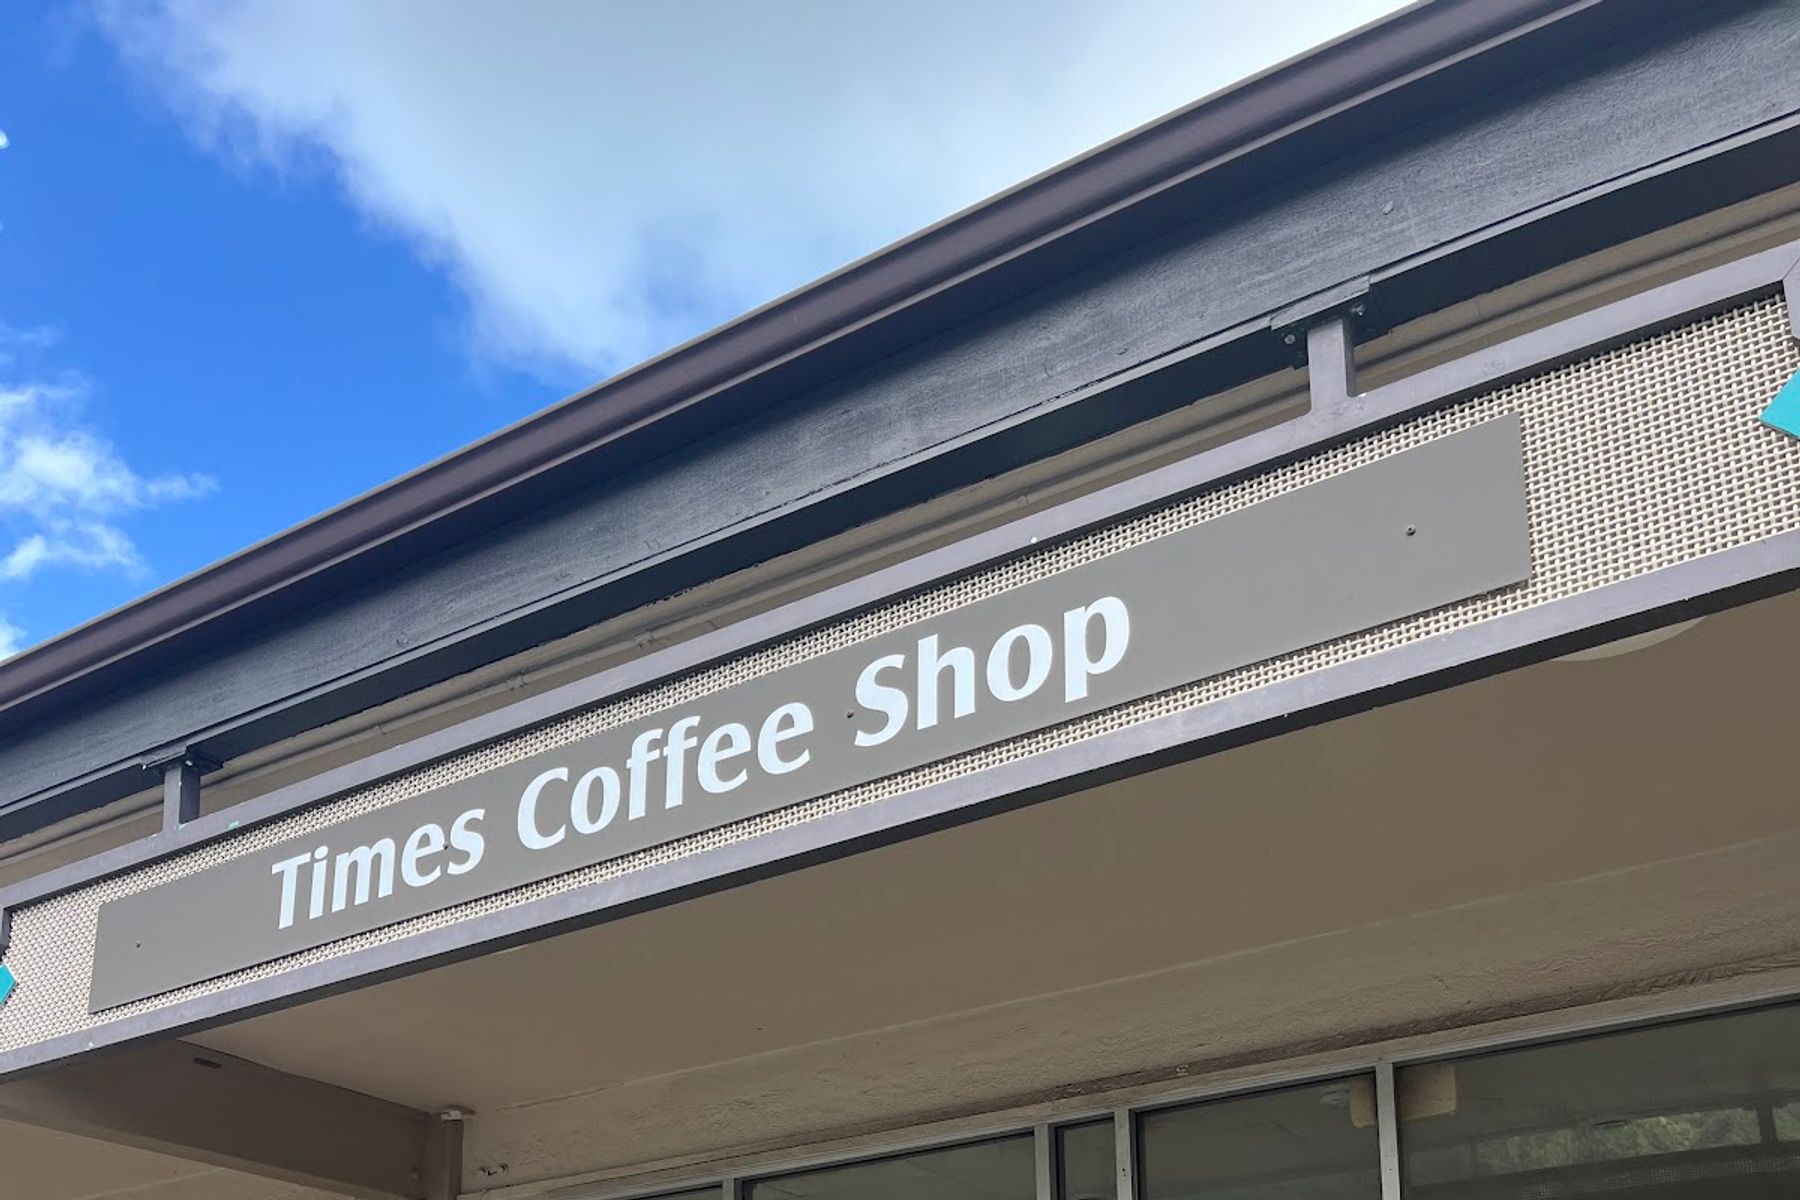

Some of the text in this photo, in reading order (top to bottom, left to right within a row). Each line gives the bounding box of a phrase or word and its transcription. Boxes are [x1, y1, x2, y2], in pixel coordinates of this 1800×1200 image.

[272, 595, 1132, 930] Times Coffee Shop
